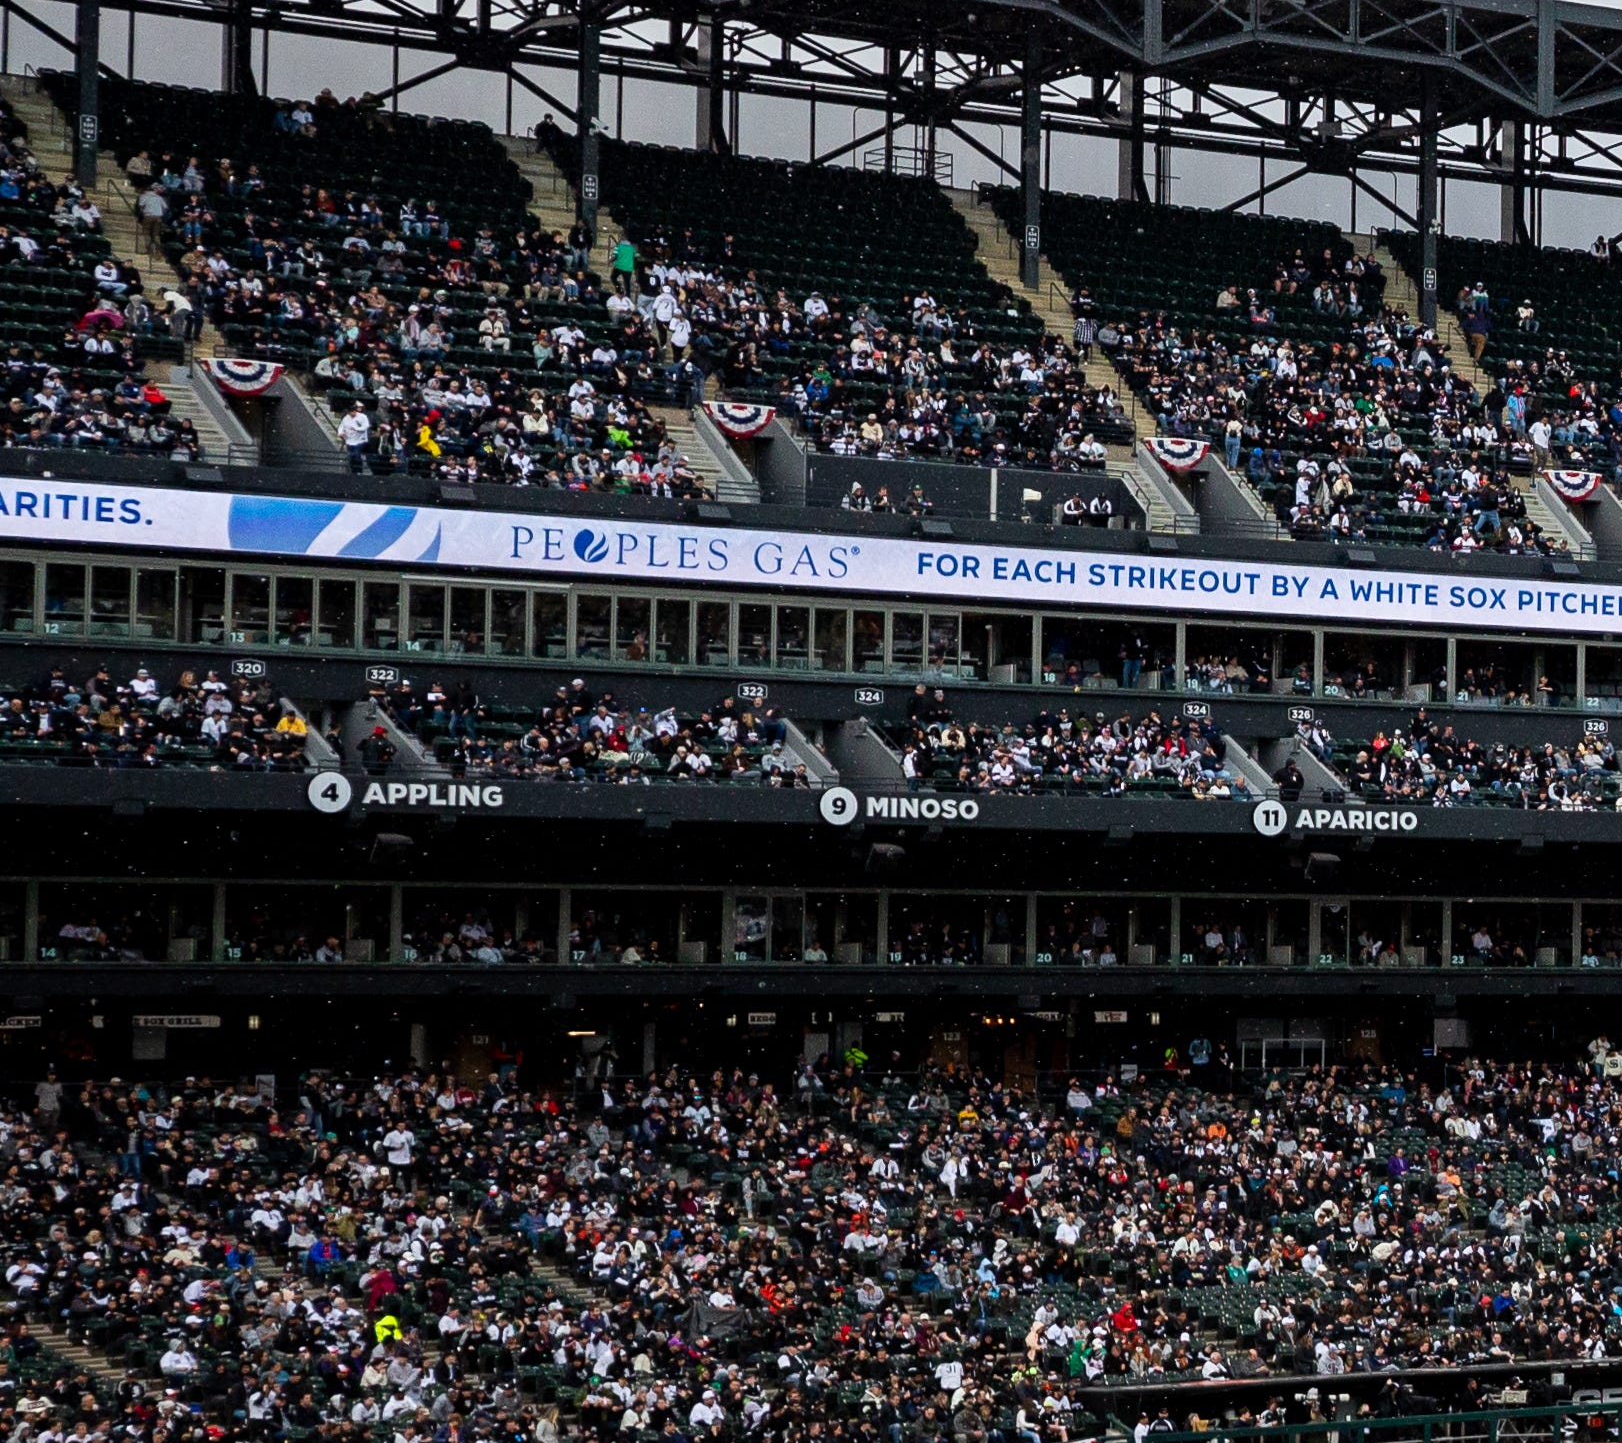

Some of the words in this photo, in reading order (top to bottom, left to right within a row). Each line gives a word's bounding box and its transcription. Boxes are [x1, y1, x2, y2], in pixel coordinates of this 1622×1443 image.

[0, 490, 153, 526] RITIES.
[917, 551, 981, 579] FOR
[992, 556, 1076, 585] EACH
[1088, 563, 1261, 595] STRIKEOUT
[1271, 574, 1310, 598] BY
[1319, 577, 1340, 601] A
[1349, 579, 1439, 607] WHITE
[1449, 585, 1507, 610] SOX
[237, 663, 261, 674] 320
[371, 670, 393, 680] 322
[742, 687, 763, 696] 322
[859, 692, 880, 701] 324
[1187, 706, 1207, 715] 324
[1292, 711, 1311, 720] 326
[1587, 722, 1605, 732] 326
[321, 783, 339, 802] 4
[363, 781, 503, 807] APPLING
[832, 798, 846, 815] 9
[1262, 810, 1280, 827] 11
[1296, 808, 1418, 831] APARICIO
